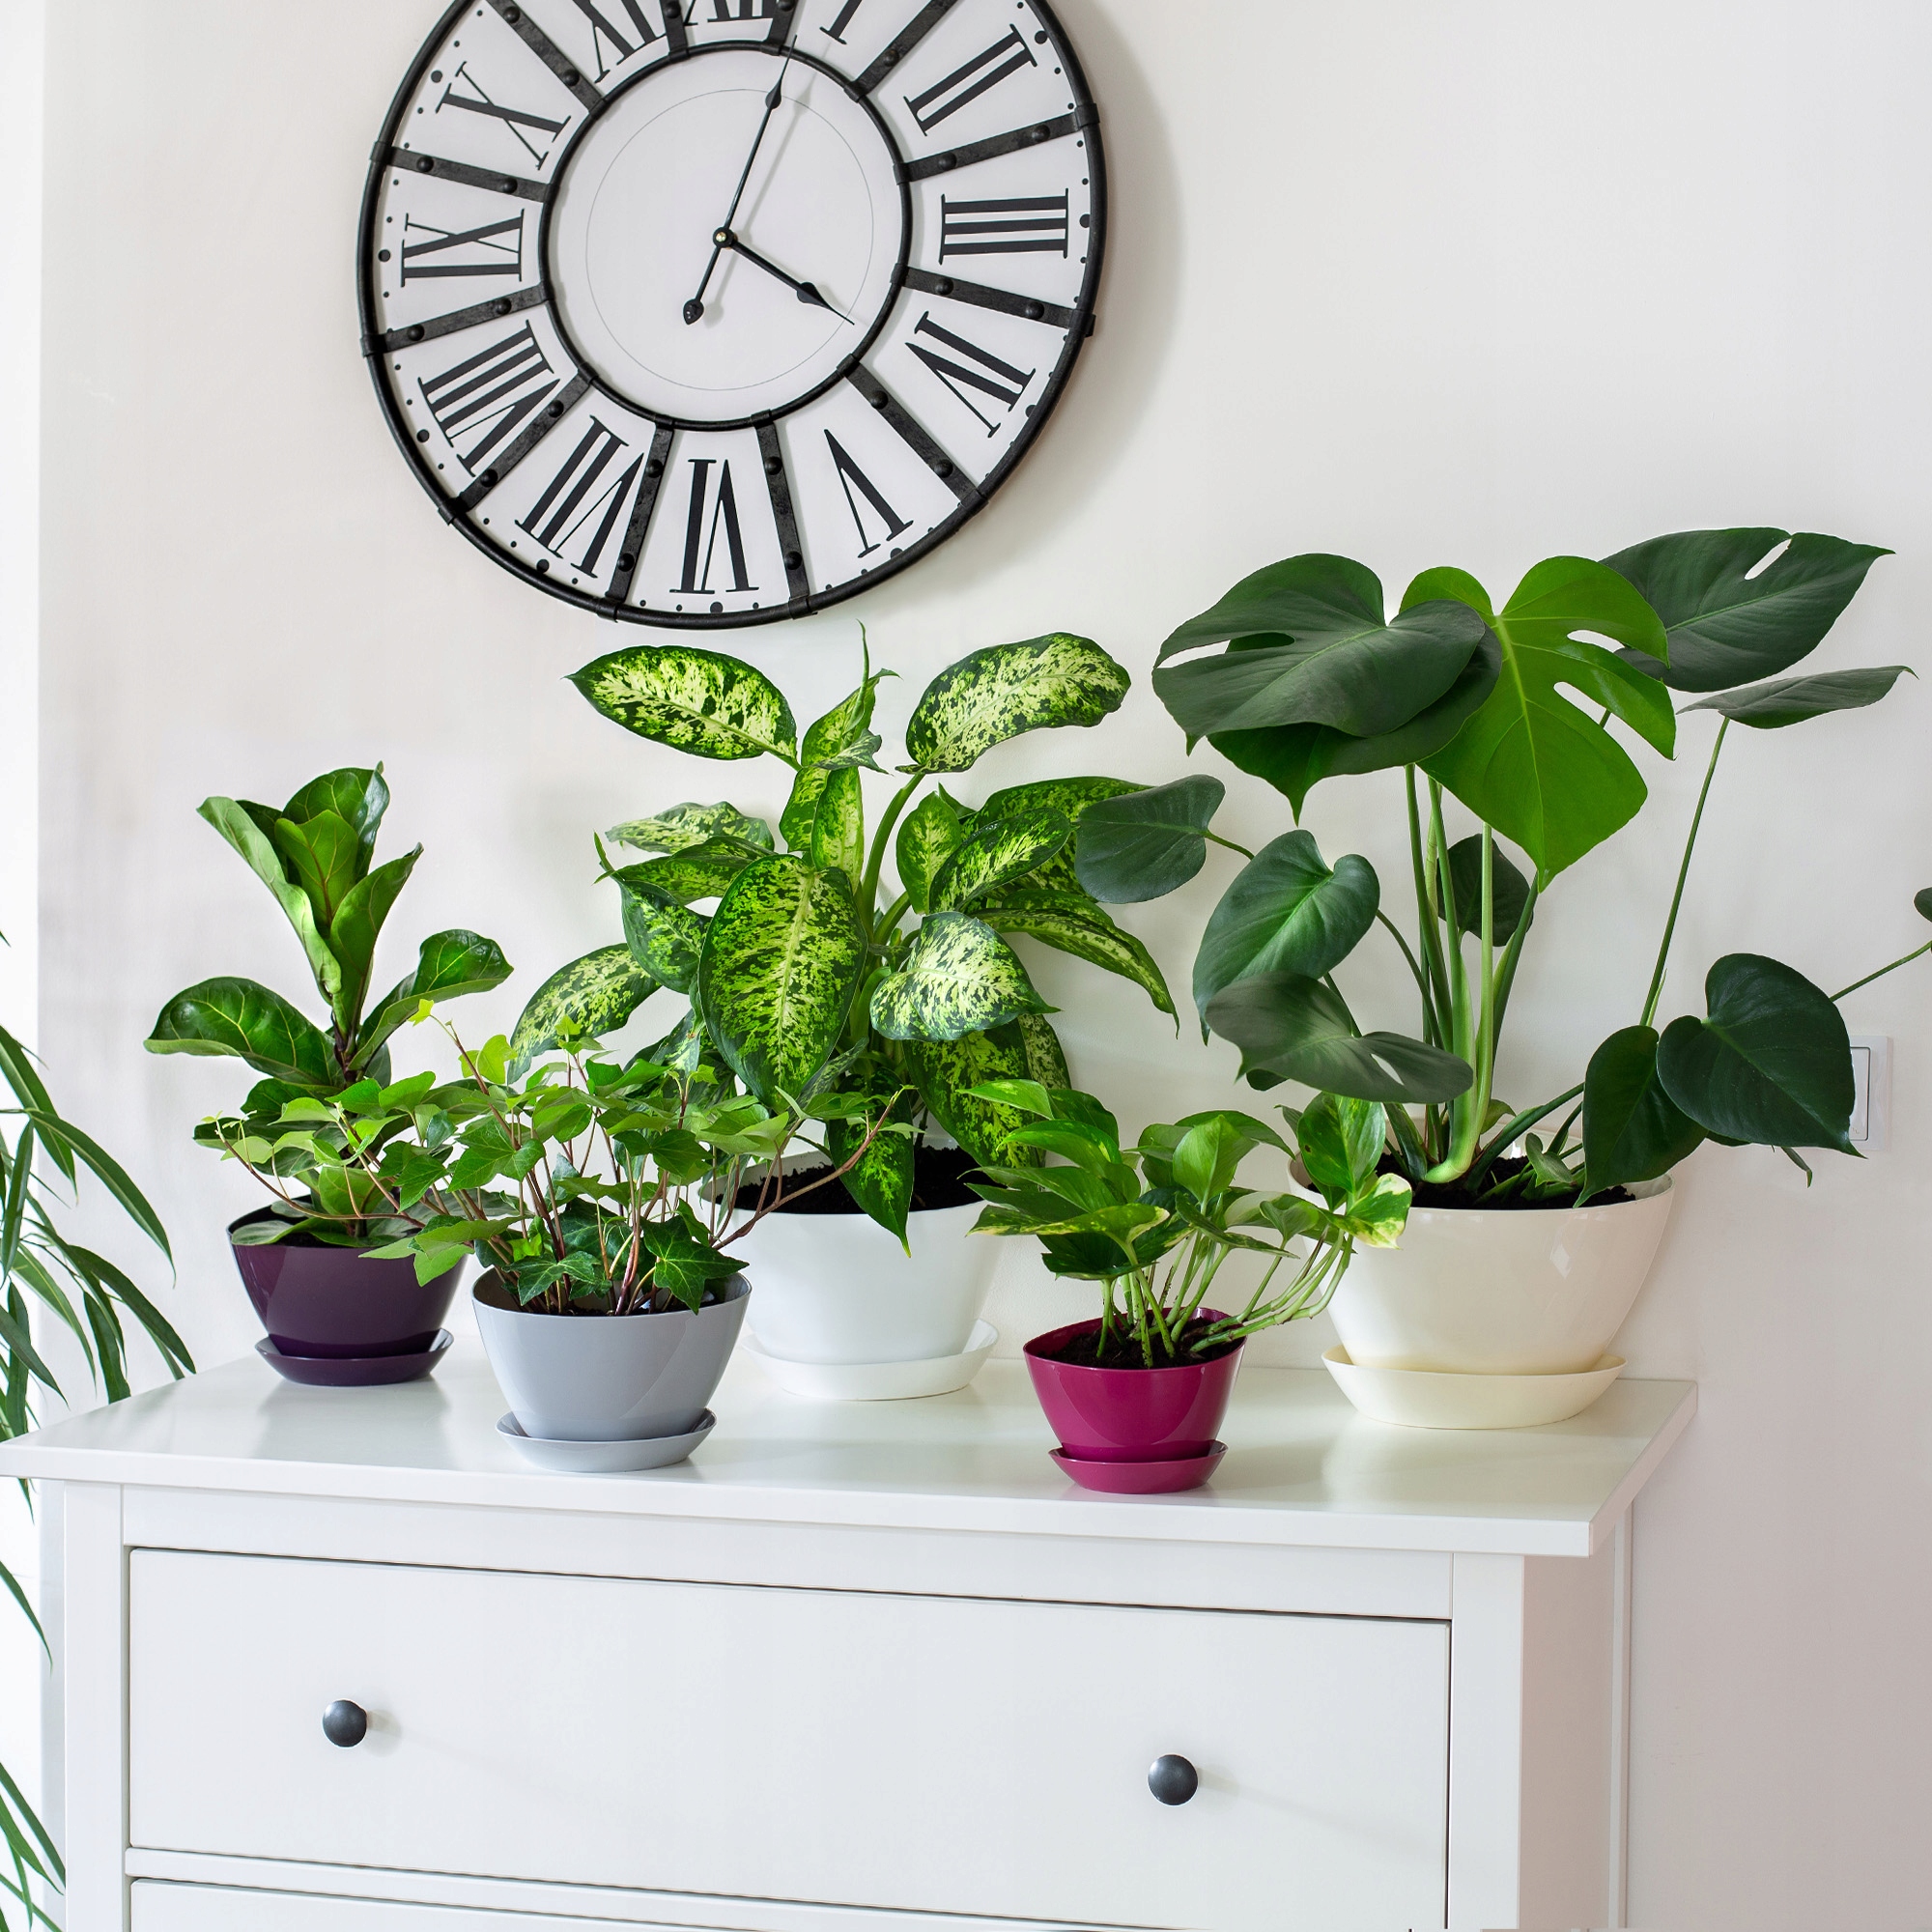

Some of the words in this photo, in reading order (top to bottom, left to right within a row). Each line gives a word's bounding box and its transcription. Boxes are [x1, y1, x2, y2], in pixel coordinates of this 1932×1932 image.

[436, 61, 571, 170] X
[903, 24, 1037, 136] II
[401, 209, 525, 287] IX
[939, 188, 1069, 265] III
[417, 320, 561, 477] VIII
[904, 311, 1037, 438] IV
[515, 415, 644, 579] VII
[669, 459, 760, 595] VI
[824, 429, 914, 558] V
